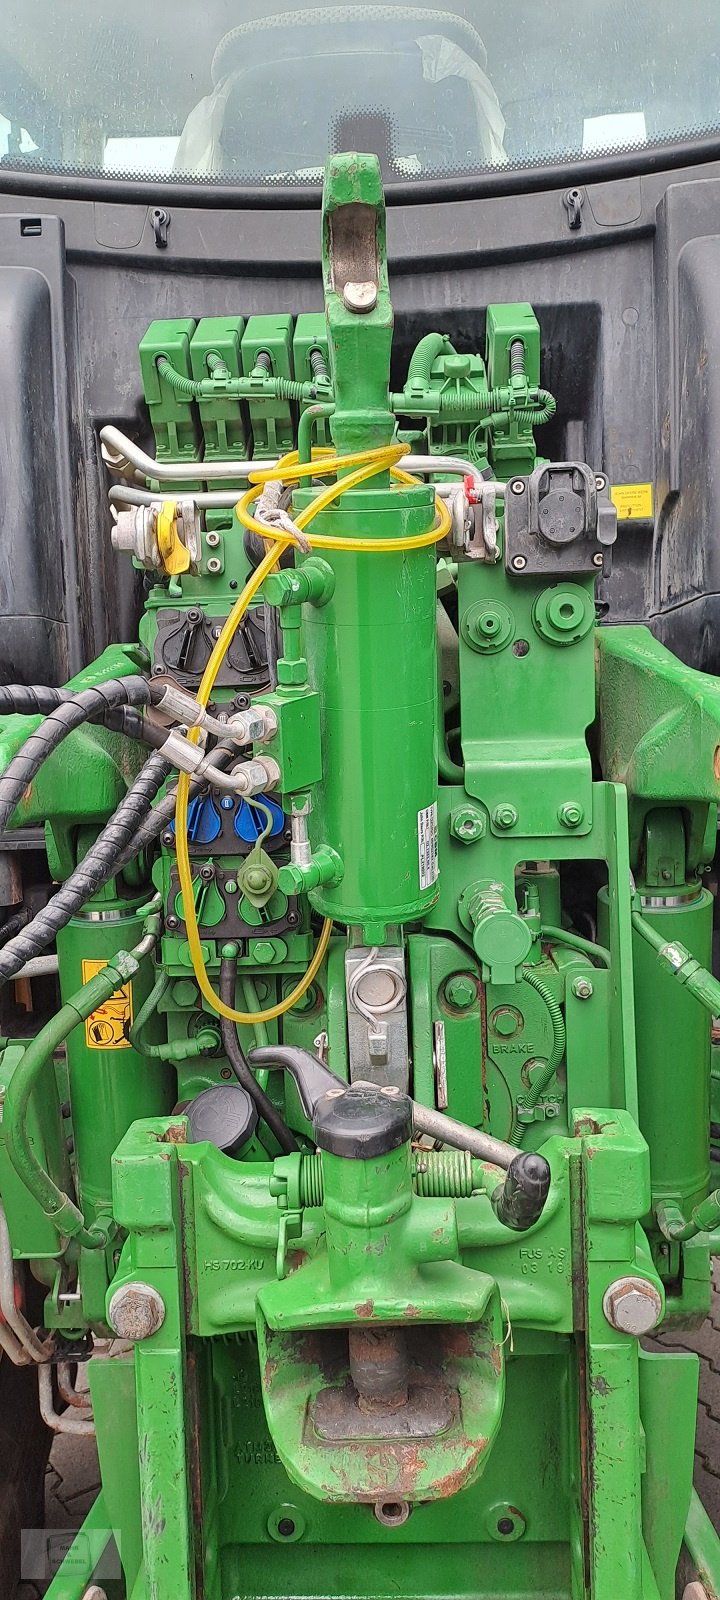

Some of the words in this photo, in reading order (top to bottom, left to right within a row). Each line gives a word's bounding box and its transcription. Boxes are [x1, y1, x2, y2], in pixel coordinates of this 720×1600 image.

[492, 1043, 535, 1054] BRAKE
[516, 1094, 564, 1104] CTCH
[520, 1247, 543, 1259] FUS
[204, 1260, 220, 1271] HS
